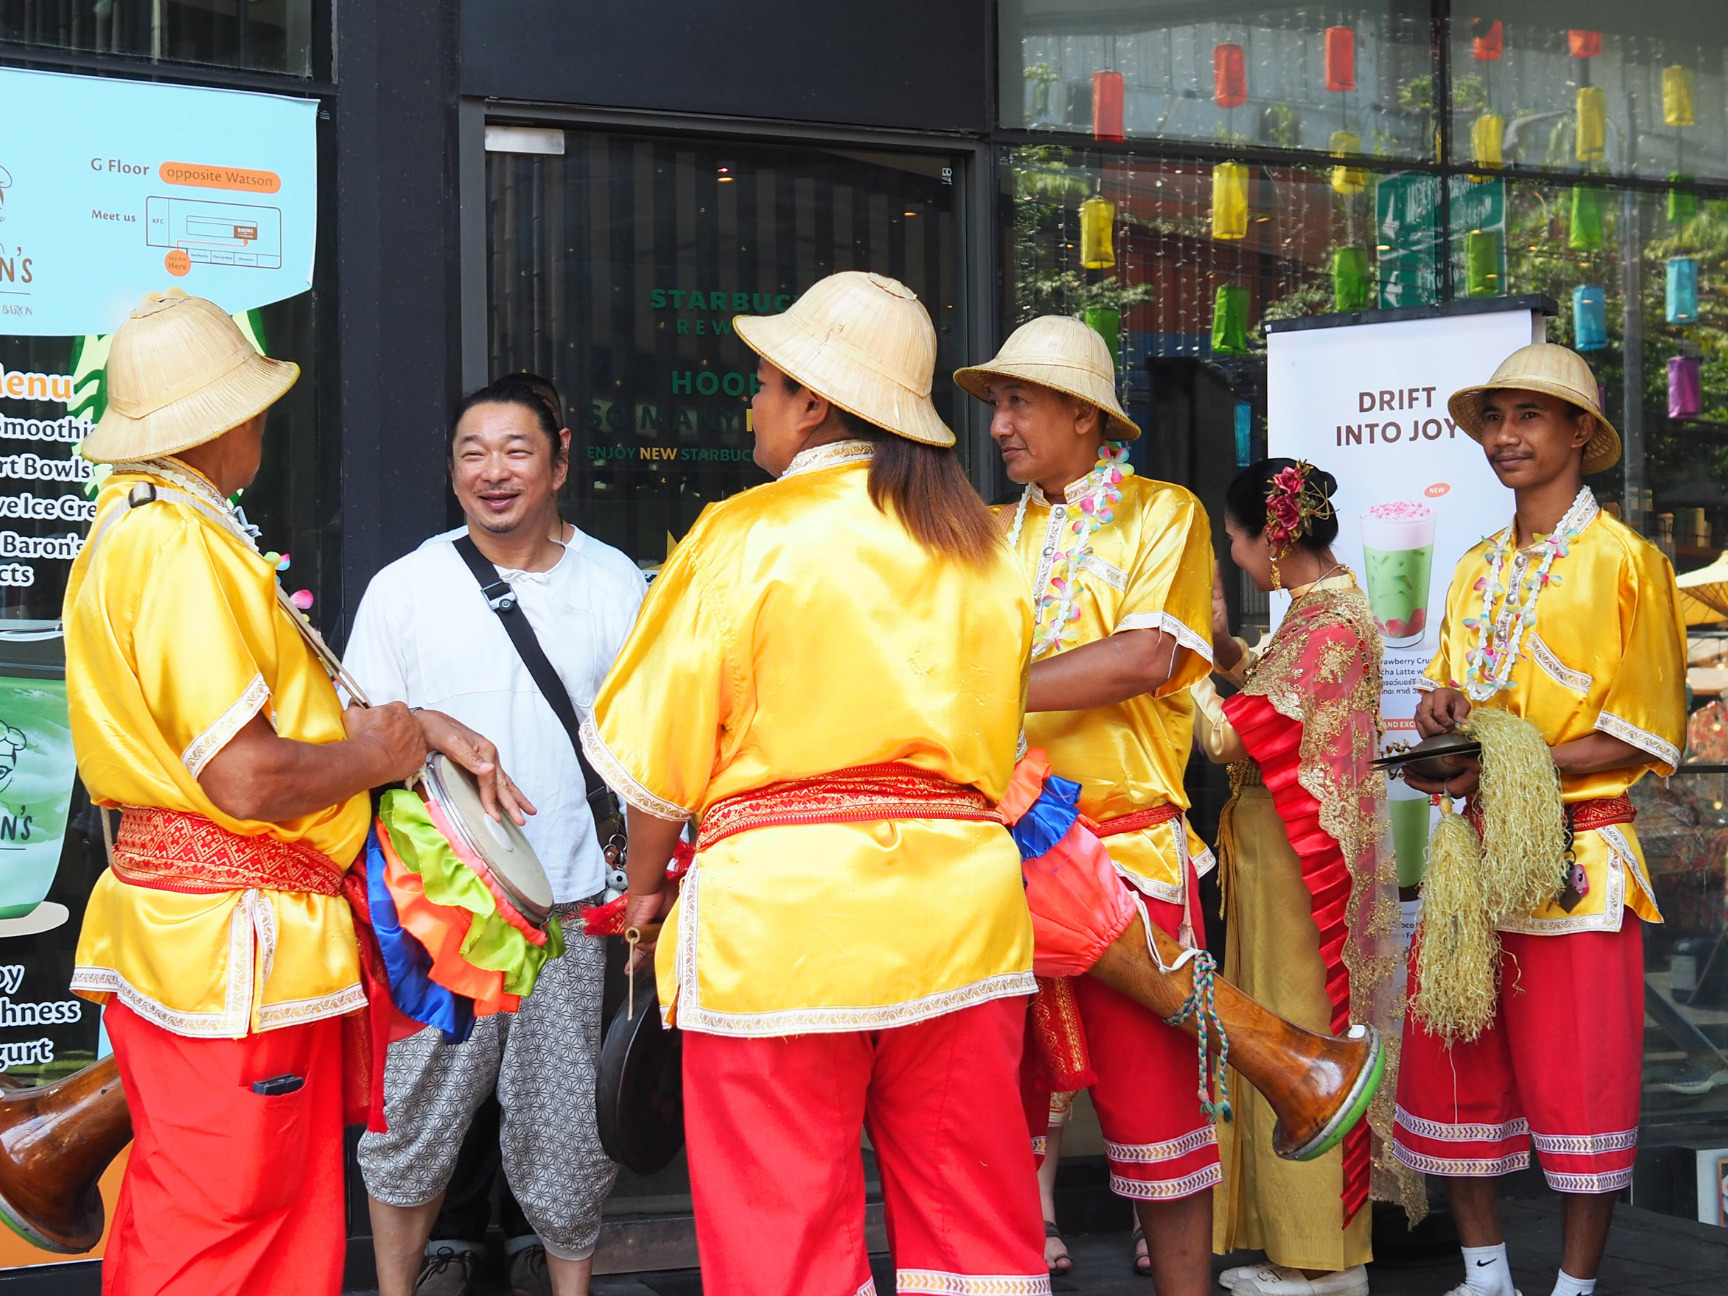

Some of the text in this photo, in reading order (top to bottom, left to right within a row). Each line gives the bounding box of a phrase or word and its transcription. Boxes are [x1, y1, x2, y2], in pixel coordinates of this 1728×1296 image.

[90, 157, 273, 187] G Floor opposite Watson
[91, 209, 136, 222] Meet us
[152, 217, 165, 225] KFC
[168, 262, 187, 270] Here
[2, 304, 33, 318] BARON
[651, 289, 801, 312] STARBUC
[0, 369, 72, 399] enu
[1359, 386, 1436, 413] DRIFT
[586, 403, 629, 430] SO
[641, 405, 739, 431] MANY
[0, 420, 95, 439] moothi
[1336, 417, 1458, 447] INTO JOY
[587, 446, 636, 460] ENJOY
[640, 447, 677, 461] NEW
[24, 457, 90, 479] Bowls
[24, 496, 55, 515] Ice
[0, 805, 33, 841] N'S
[1, 1000, 79, 1022] hness
